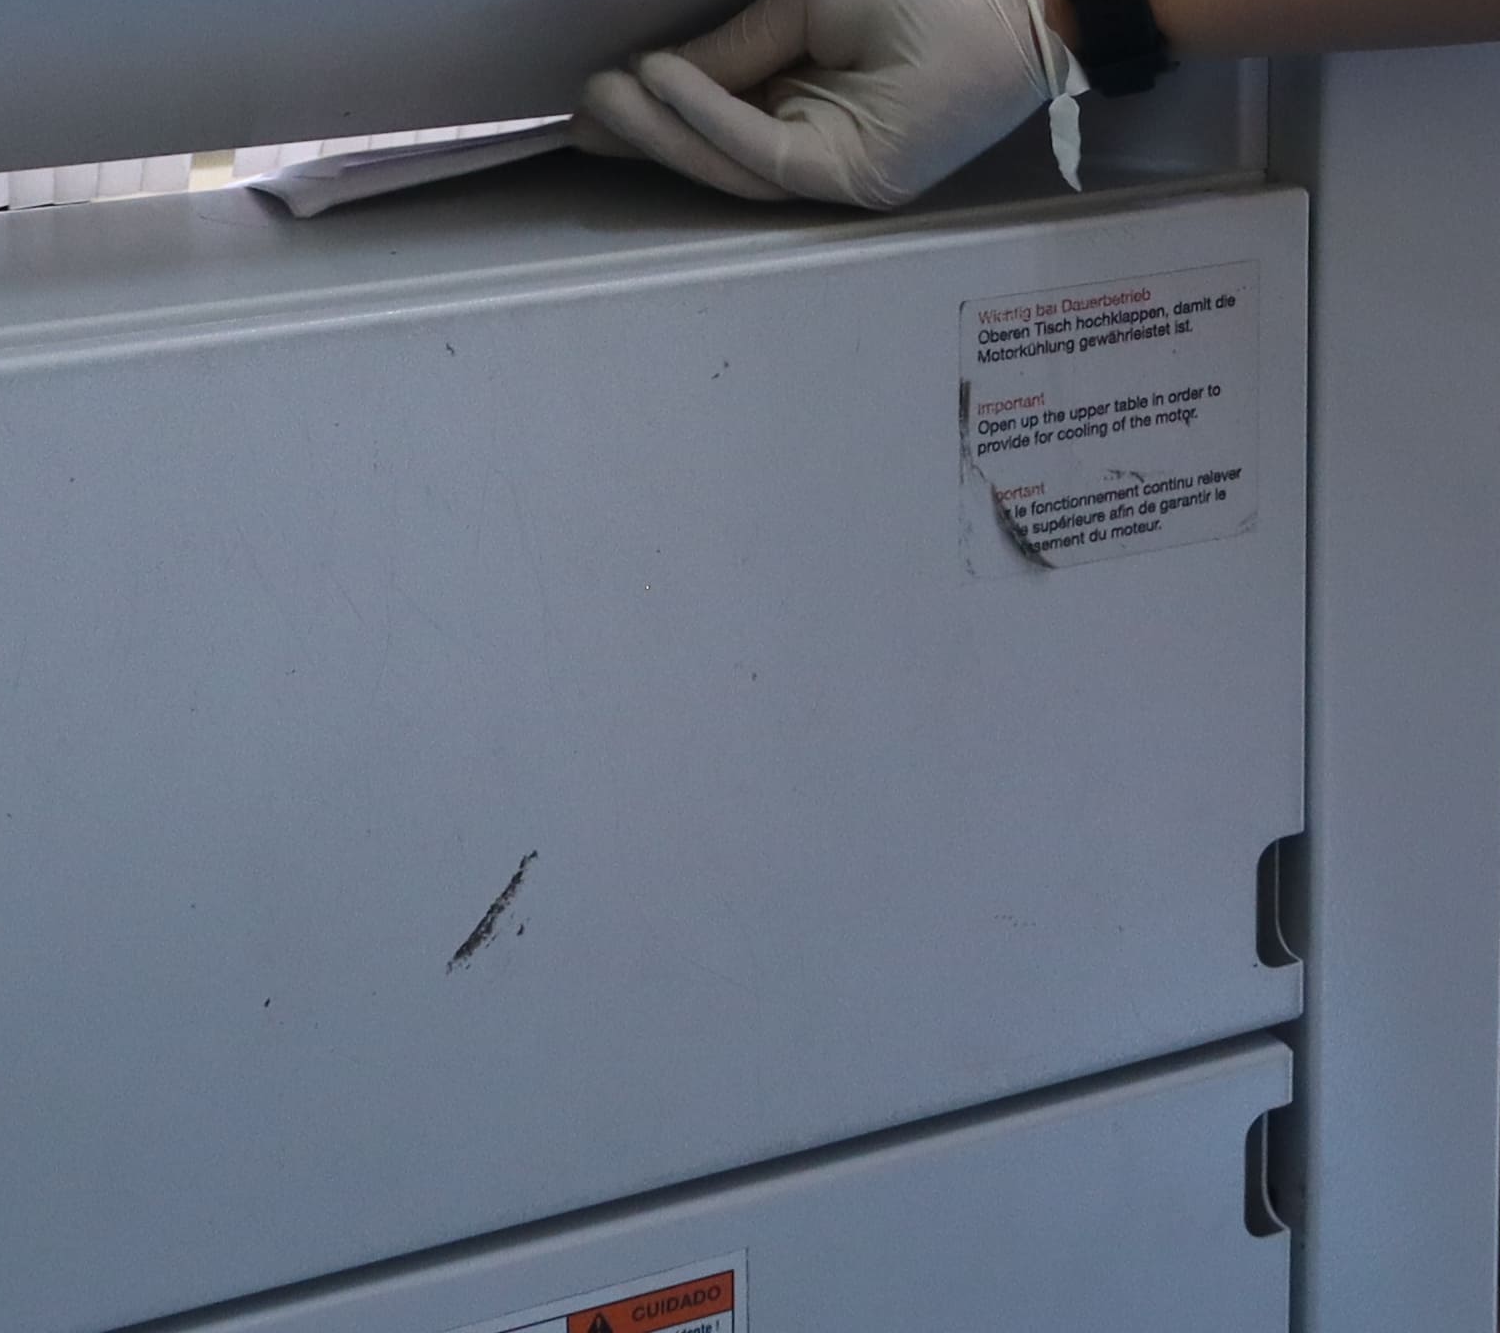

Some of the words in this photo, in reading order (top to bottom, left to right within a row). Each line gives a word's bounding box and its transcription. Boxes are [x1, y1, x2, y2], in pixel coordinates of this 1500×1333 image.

[978, 327, 1030, 345] Oberen
[1034, 317, 1072, 336] Tisch
[1076, 306, 1168, 330] hochklappen,
[1173, 297, 1212, 315] damit
[1215, 294, 1236, 309] die
[1062, 288, 1151, 312] Dauerbetrieb
[977, 339, 1075, 363] Motorkühlung
[1174, 319, 1193, 334] ist.
[977, 435, 1030, 456] provide
[1034, 430, 1054, 445] for
[1057, 422, 1108, 441] cooling
[1112, 416, 1126, 432] of
[1130, 415, 1151, 428] the
[1155, 408, 1198, 425] motor.
[978, 418, 1016, 436] Open
[1021, 415, 1039, 429] up
[1043, 410, 1065, 424] the
[1069, 403, 1111, 421] upper
[1114, 396, 1148, 412] table
[1152, 392, 1164, 406] in
[1168, 387, 1204, 403] order
[1207, 384, 1221, 397] to
[1015, 505, 1027, 518] le
[1031, 485, 1139, 516] fonctionnement
[1143, 476, 1194, 495] continu
[1032, 512, 1105, 534] supérieure
[1109, 504, 1134, 521] afin
[1138, 501, 1156, 515] de
[1160, 489, 1211, 514] garantir
[1215, 488, 1227, 501] le
[1089, 528, 1107, 543] du
[1111, 520, 1162, 539] moteur.
[632, 1285, 722, 1322] CUIDADO
